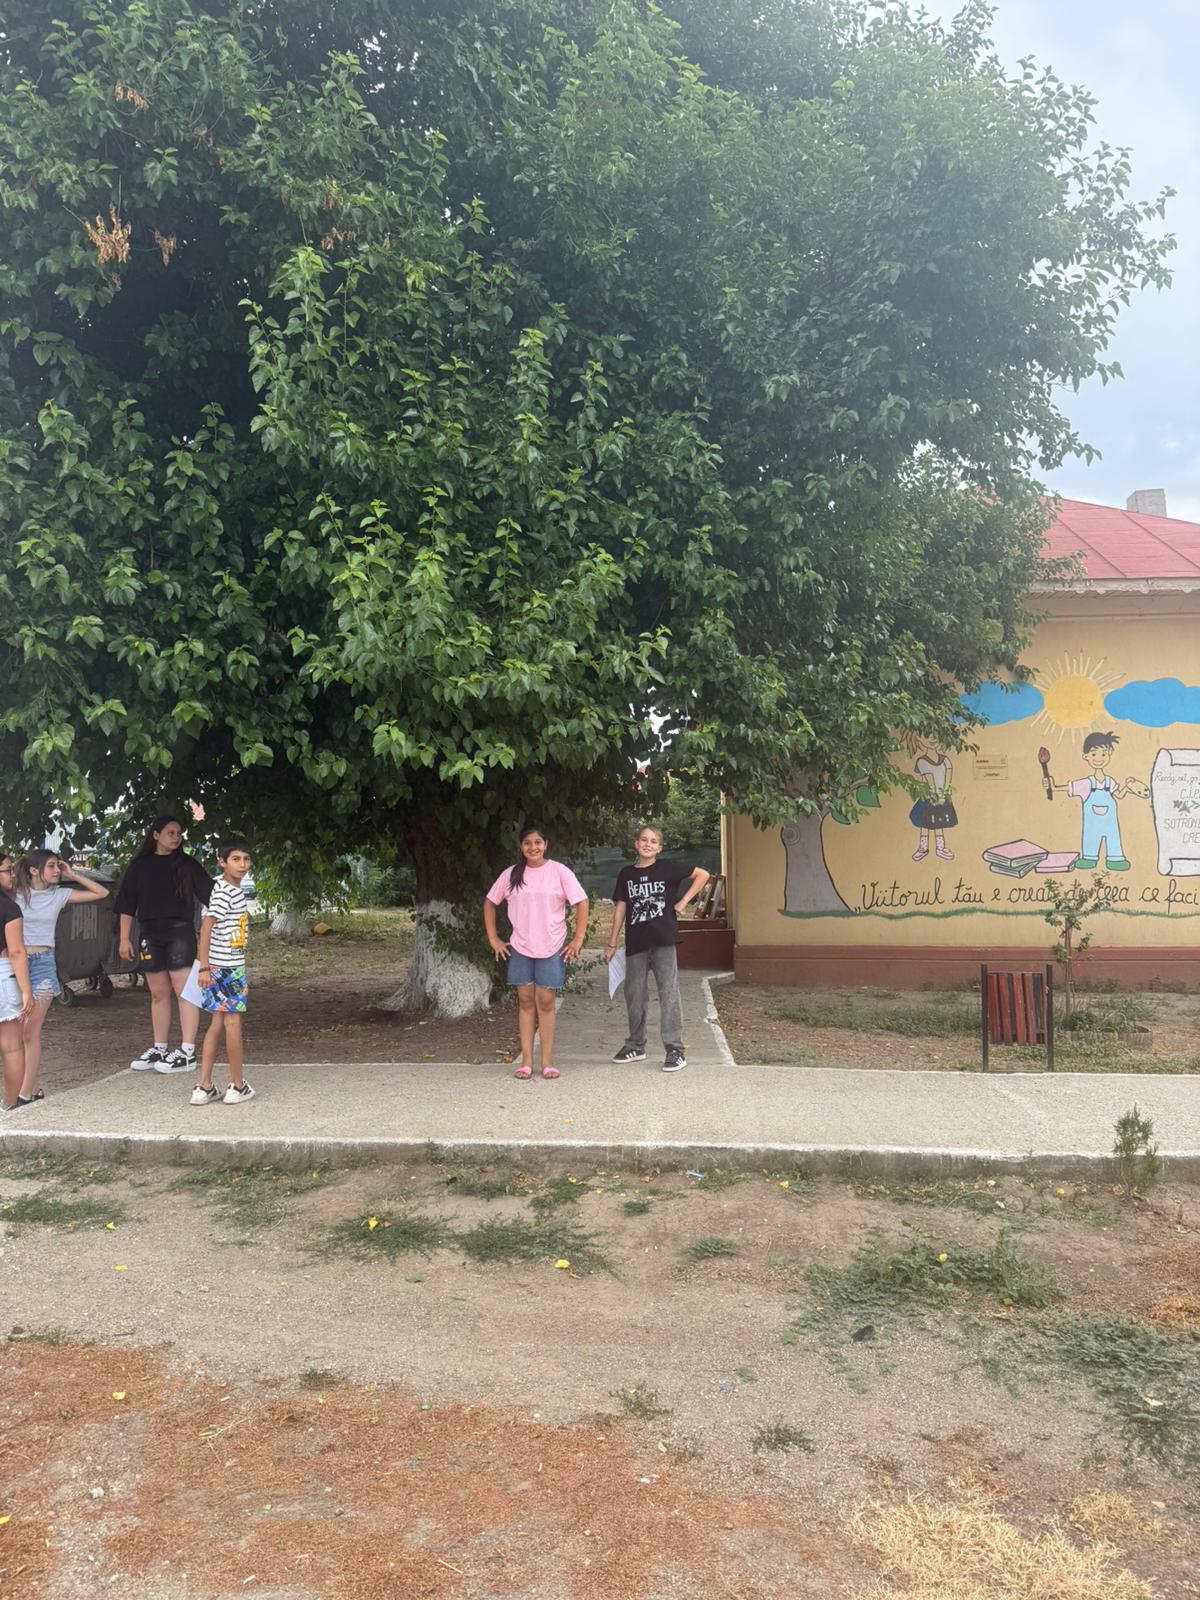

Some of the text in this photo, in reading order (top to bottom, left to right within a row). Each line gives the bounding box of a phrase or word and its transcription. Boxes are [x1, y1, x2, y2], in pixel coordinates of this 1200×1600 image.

[627, 880, 665, 898] BEATLES
[951, 877, 985, 903] tău
[990, 887, 1002, 901] e
[1138, 886, 1161, 904] ce
[1164, 878, 1200, 915] faci
